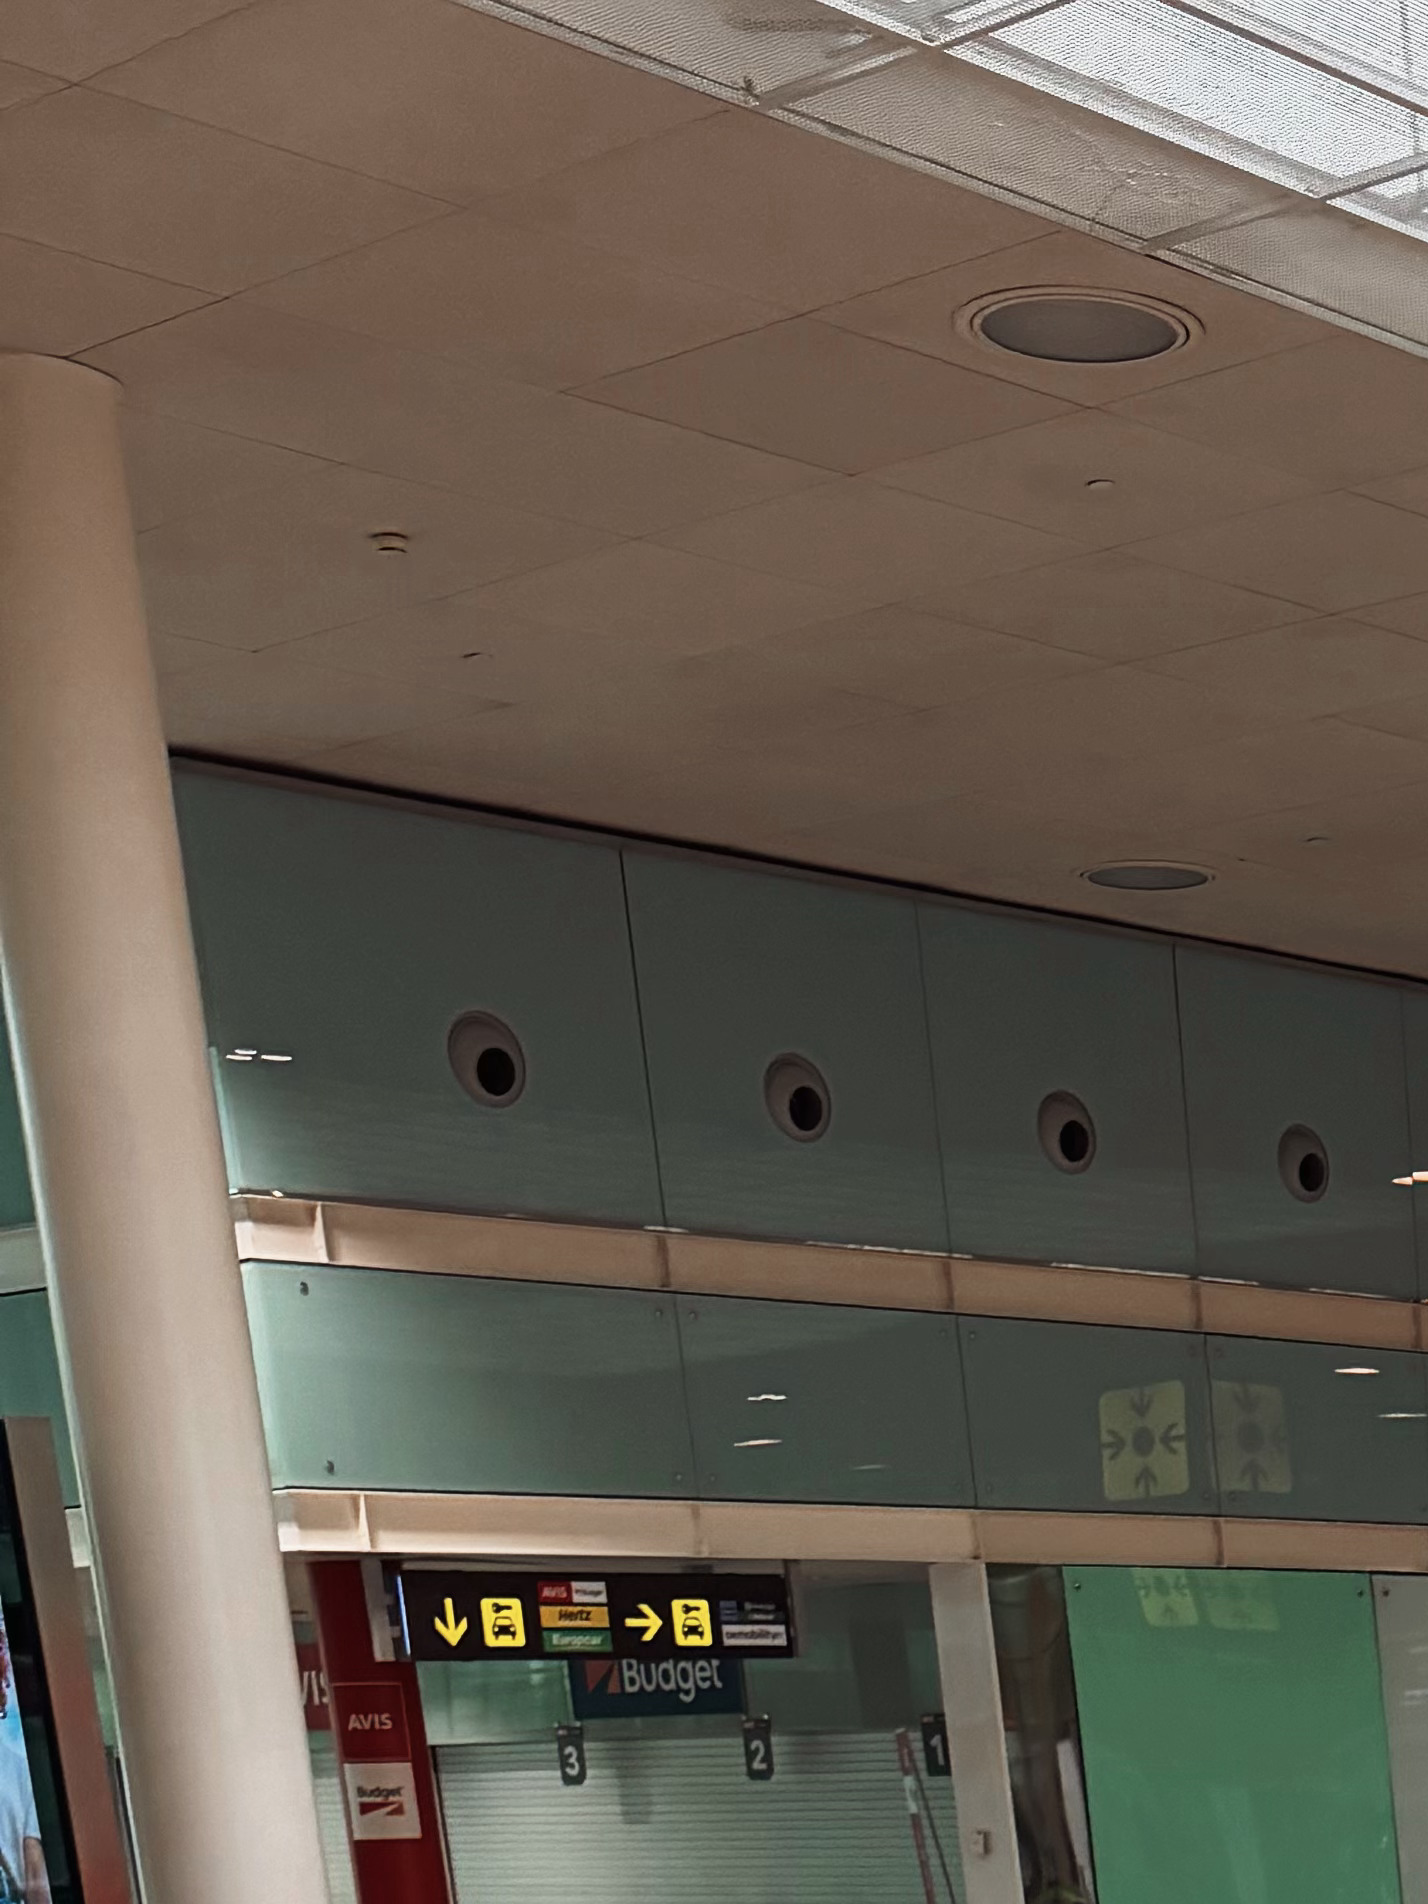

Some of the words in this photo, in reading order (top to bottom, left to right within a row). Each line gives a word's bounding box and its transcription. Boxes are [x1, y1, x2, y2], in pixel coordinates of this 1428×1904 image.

[558, 1609, 593, 1622] Hertz
[621, 1658, 723, 1703] Budget
[348, 1713, 393, 1731] AVIS
[563, 1746, 581, 1776] 3
[750, 1740, 768, 1770] 2
[929, 1735, 946, 1766] 1
